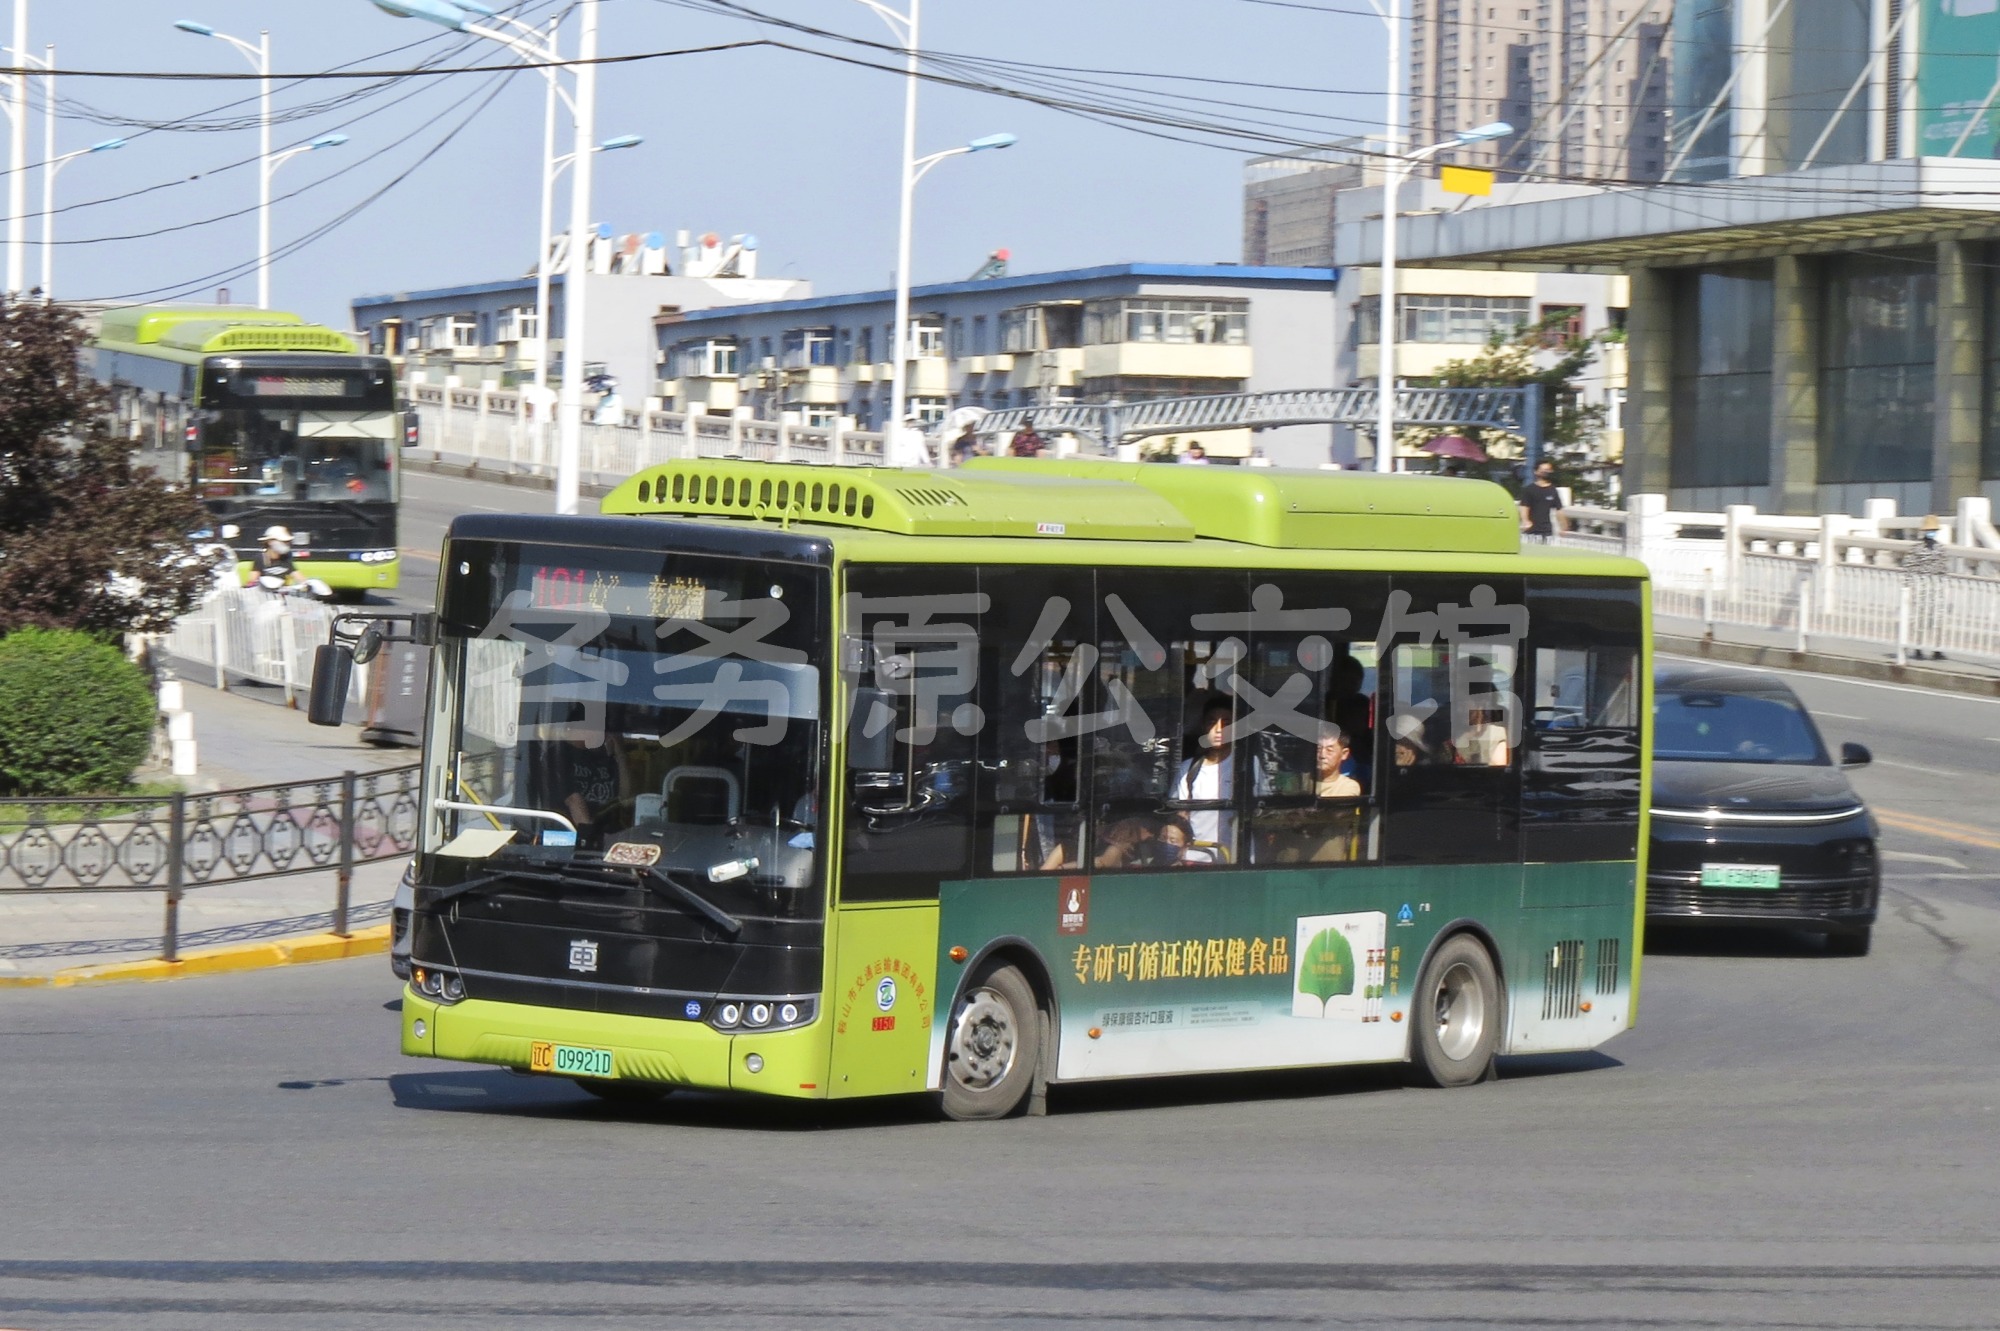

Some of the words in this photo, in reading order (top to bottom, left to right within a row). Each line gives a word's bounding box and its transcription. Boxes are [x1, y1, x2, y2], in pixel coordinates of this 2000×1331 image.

[536, 566, 586, 611] 101
[1071, 936, 1289, 985] 专研可循证的保健食品
[873, 1017, 895, 1031] 3150
